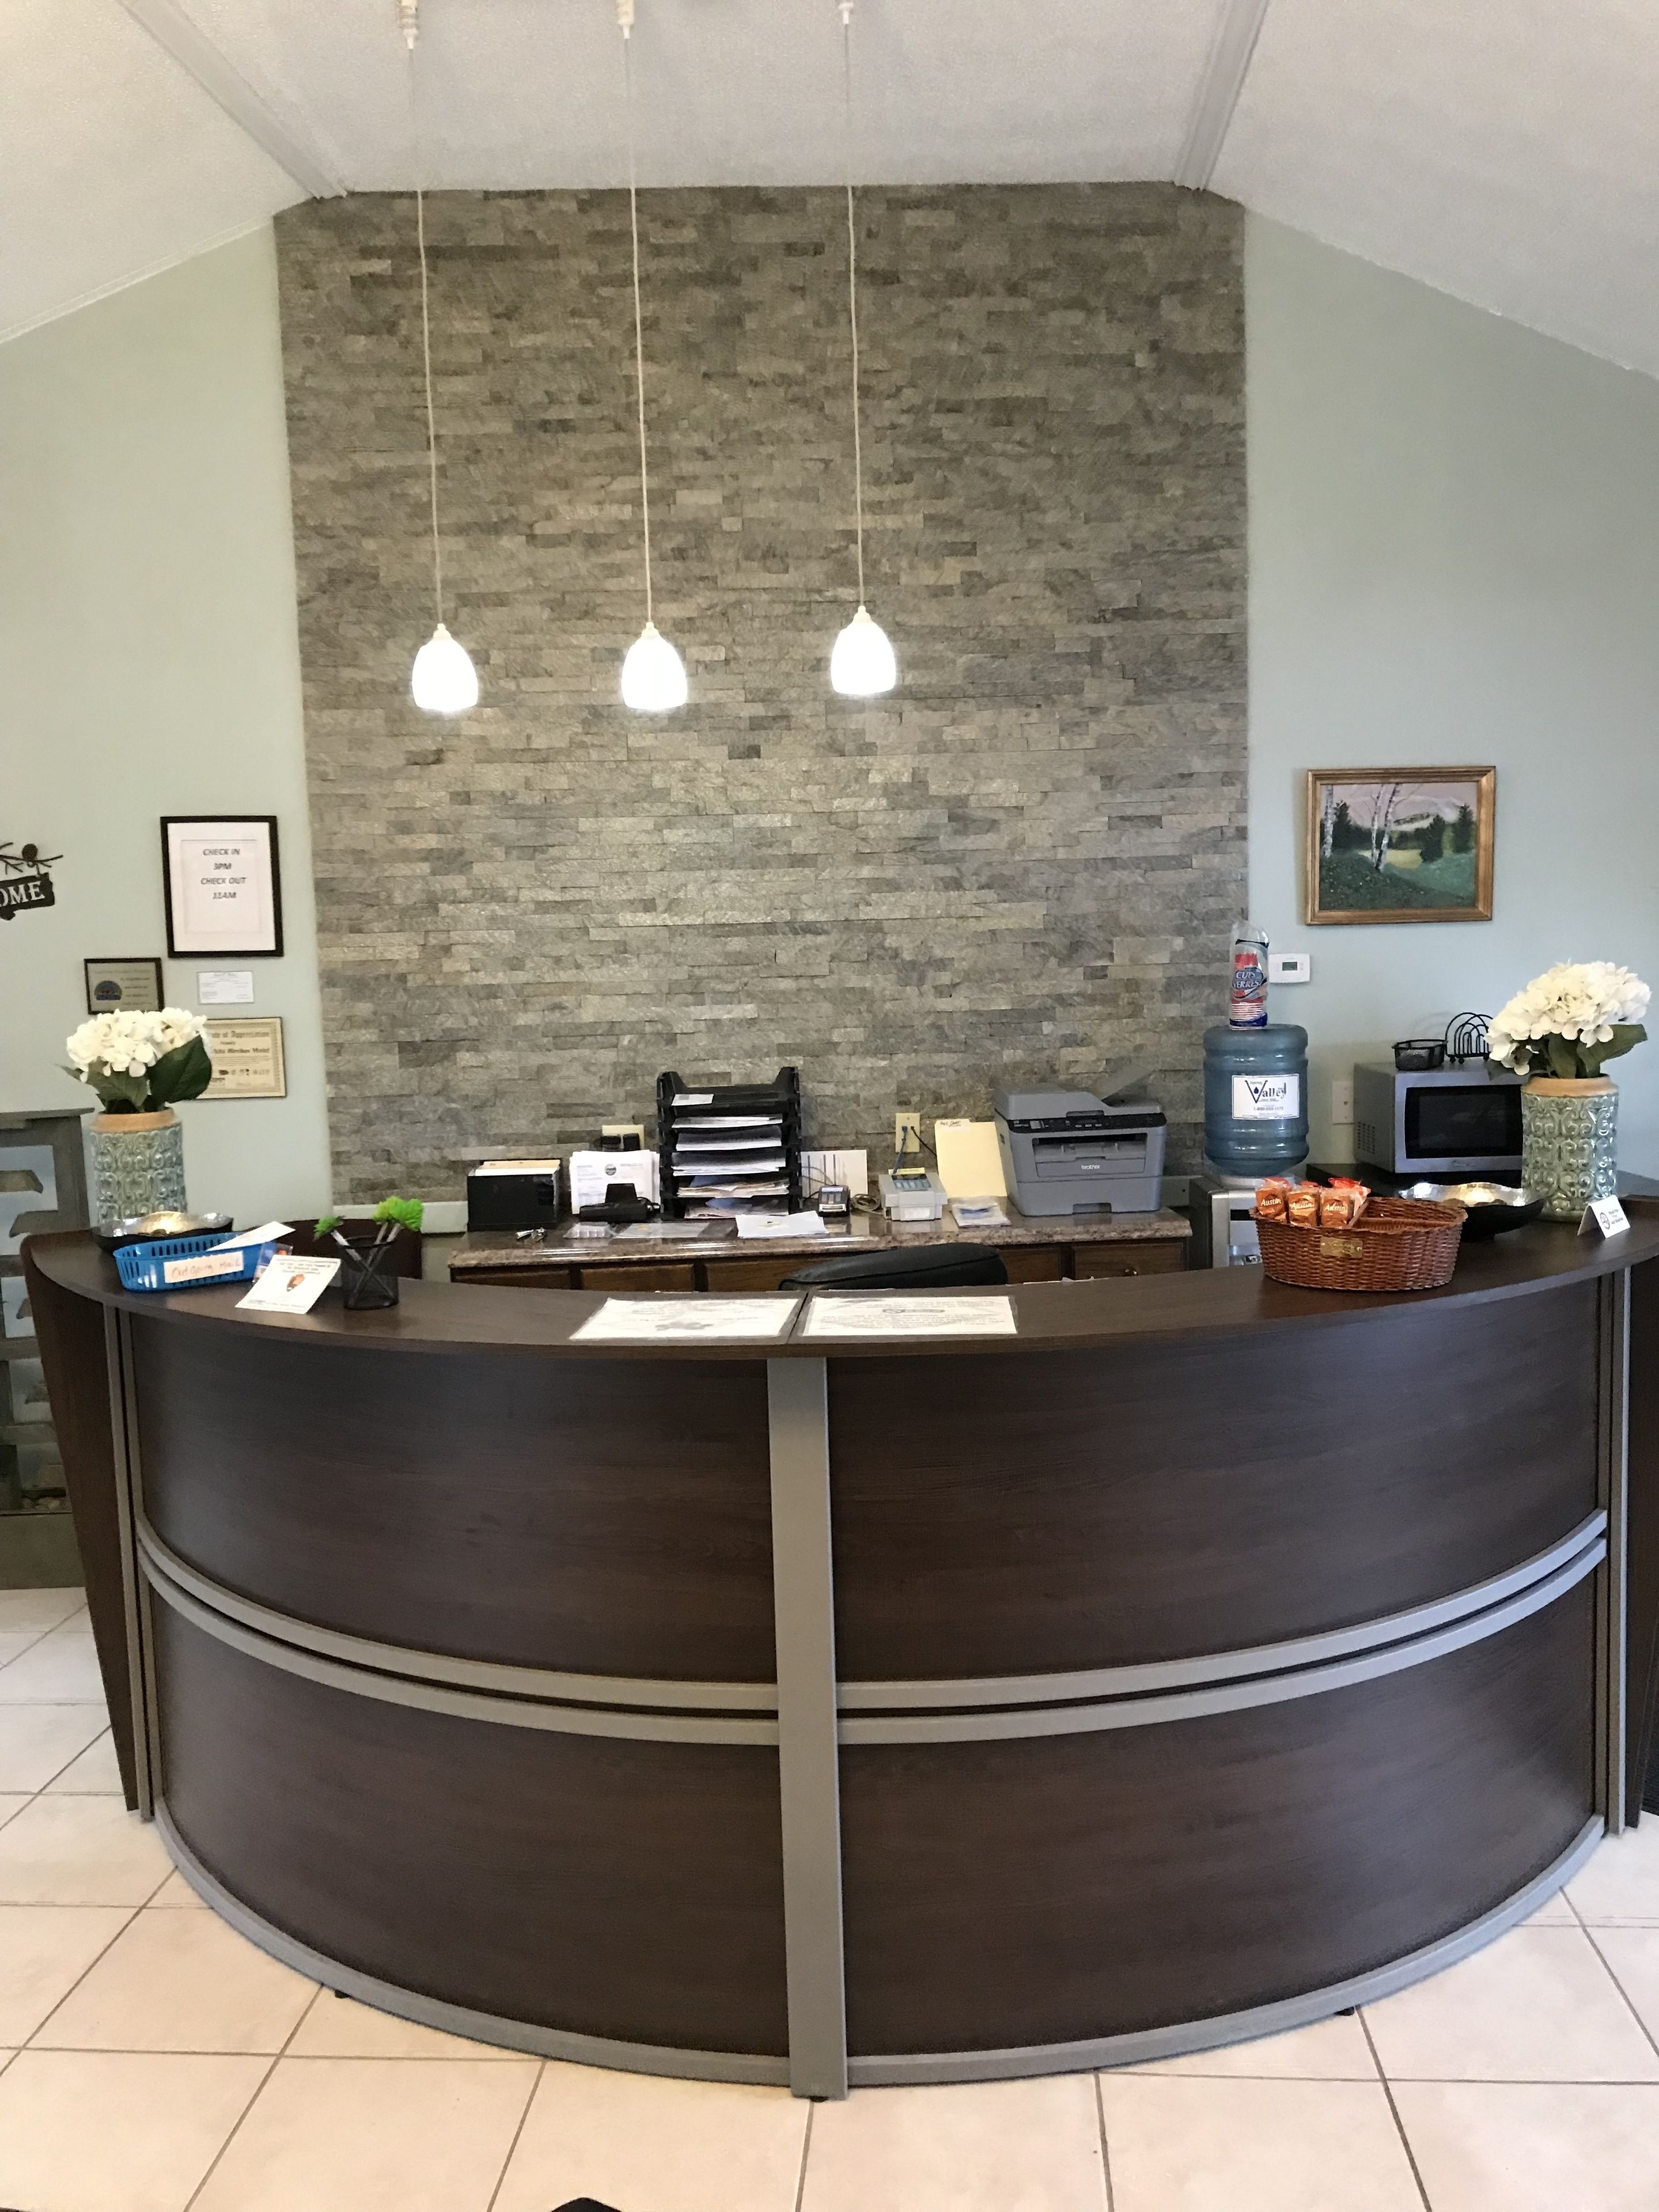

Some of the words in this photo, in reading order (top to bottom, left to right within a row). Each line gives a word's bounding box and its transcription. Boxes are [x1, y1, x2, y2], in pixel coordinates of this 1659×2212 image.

[1245, 1080, 1286, 1103] Valley
[1260, 1198, 1281, 1206] Austin
[1291, 1202, 1313, 1210] Austin
